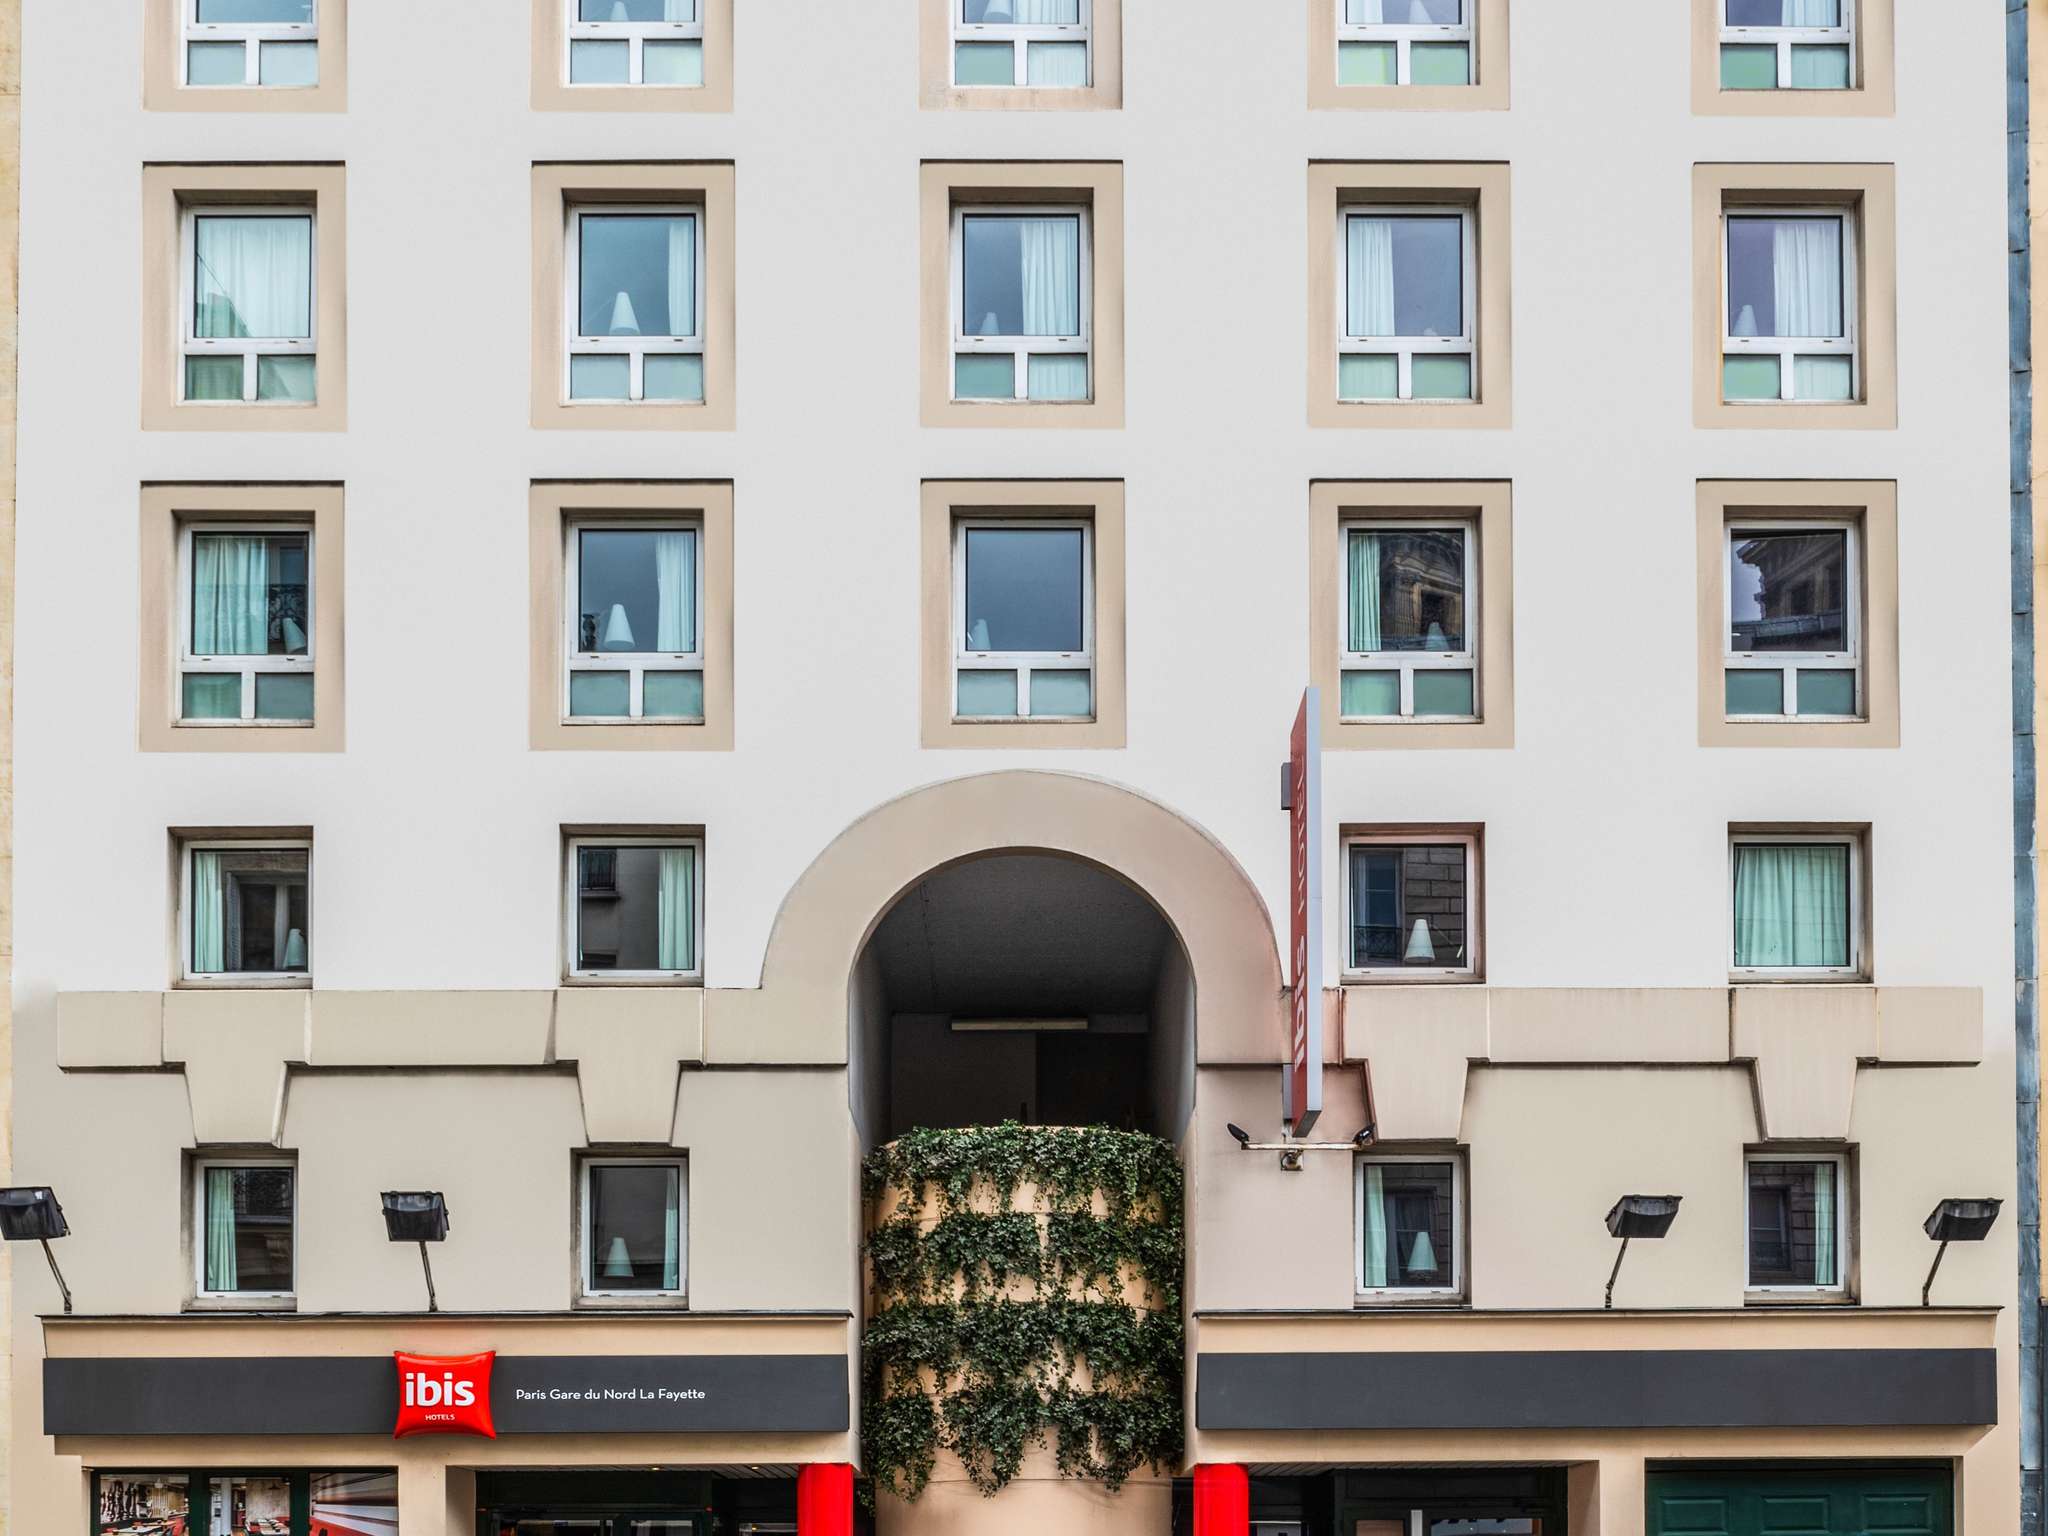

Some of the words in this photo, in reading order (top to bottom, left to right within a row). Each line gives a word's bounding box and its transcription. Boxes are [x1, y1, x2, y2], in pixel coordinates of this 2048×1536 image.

[405, 1372, 476, 1407] ibis
[516, 1388, 546, 1400] Paris
[550, 1388, 581, 1400] Gare
[584, 1388, 601, 1400] du
[604, 1388, 635, 1400] Nord
[640, 1388, 655, 1399] La
[658, 1388, 706, 1402] Fayette
[425, 1413, 456, 1421] HOTELS
